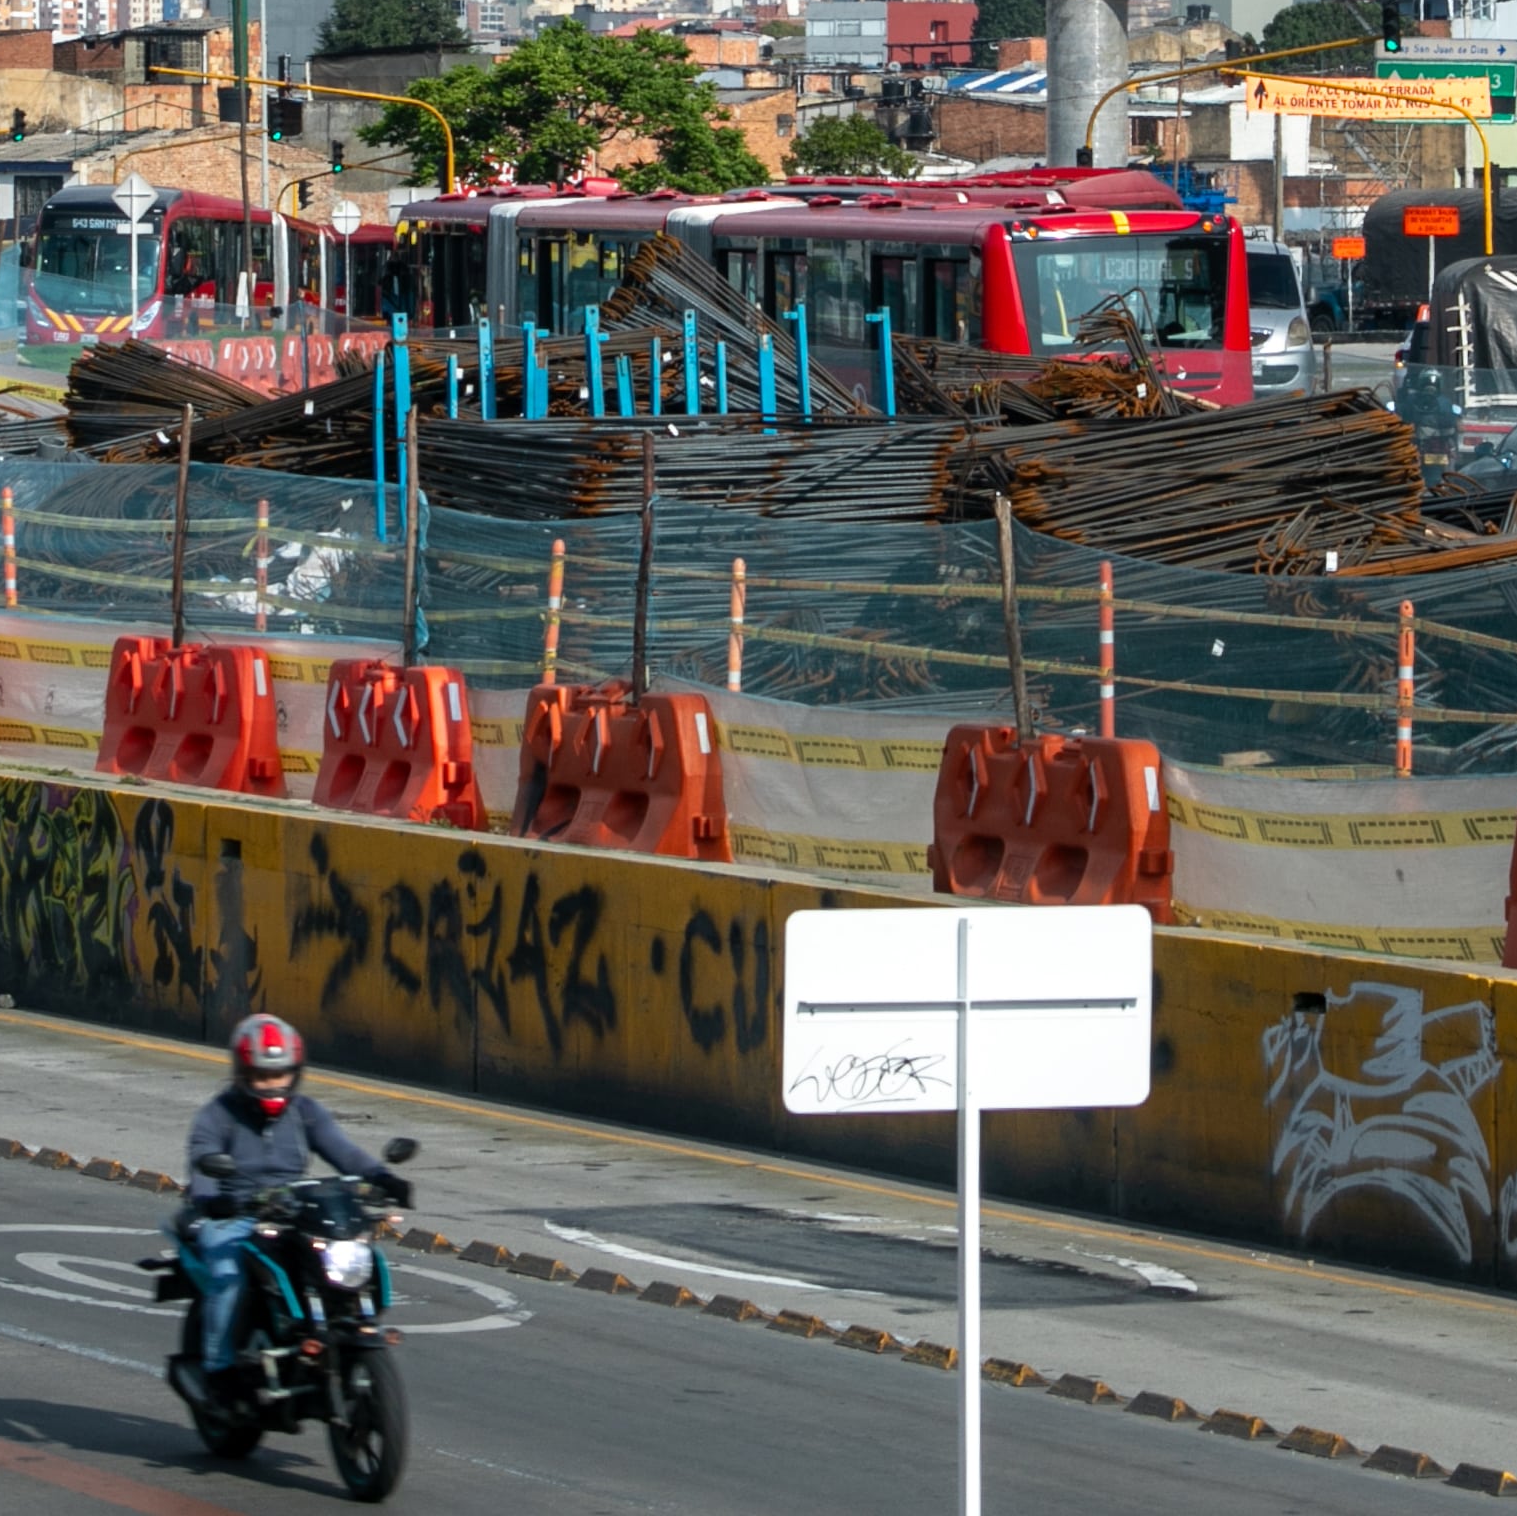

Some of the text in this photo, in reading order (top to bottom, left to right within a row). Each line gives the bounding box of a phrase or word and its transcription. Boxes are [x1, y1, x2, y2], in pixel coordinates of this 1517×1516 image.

[1414, 45, 1430, 53] San
[1434, 45, 1454, 54] Juan
[1381, 85, 1435, 96] CERRADA
[1290, 97, 1337, 109] ORIENTE
